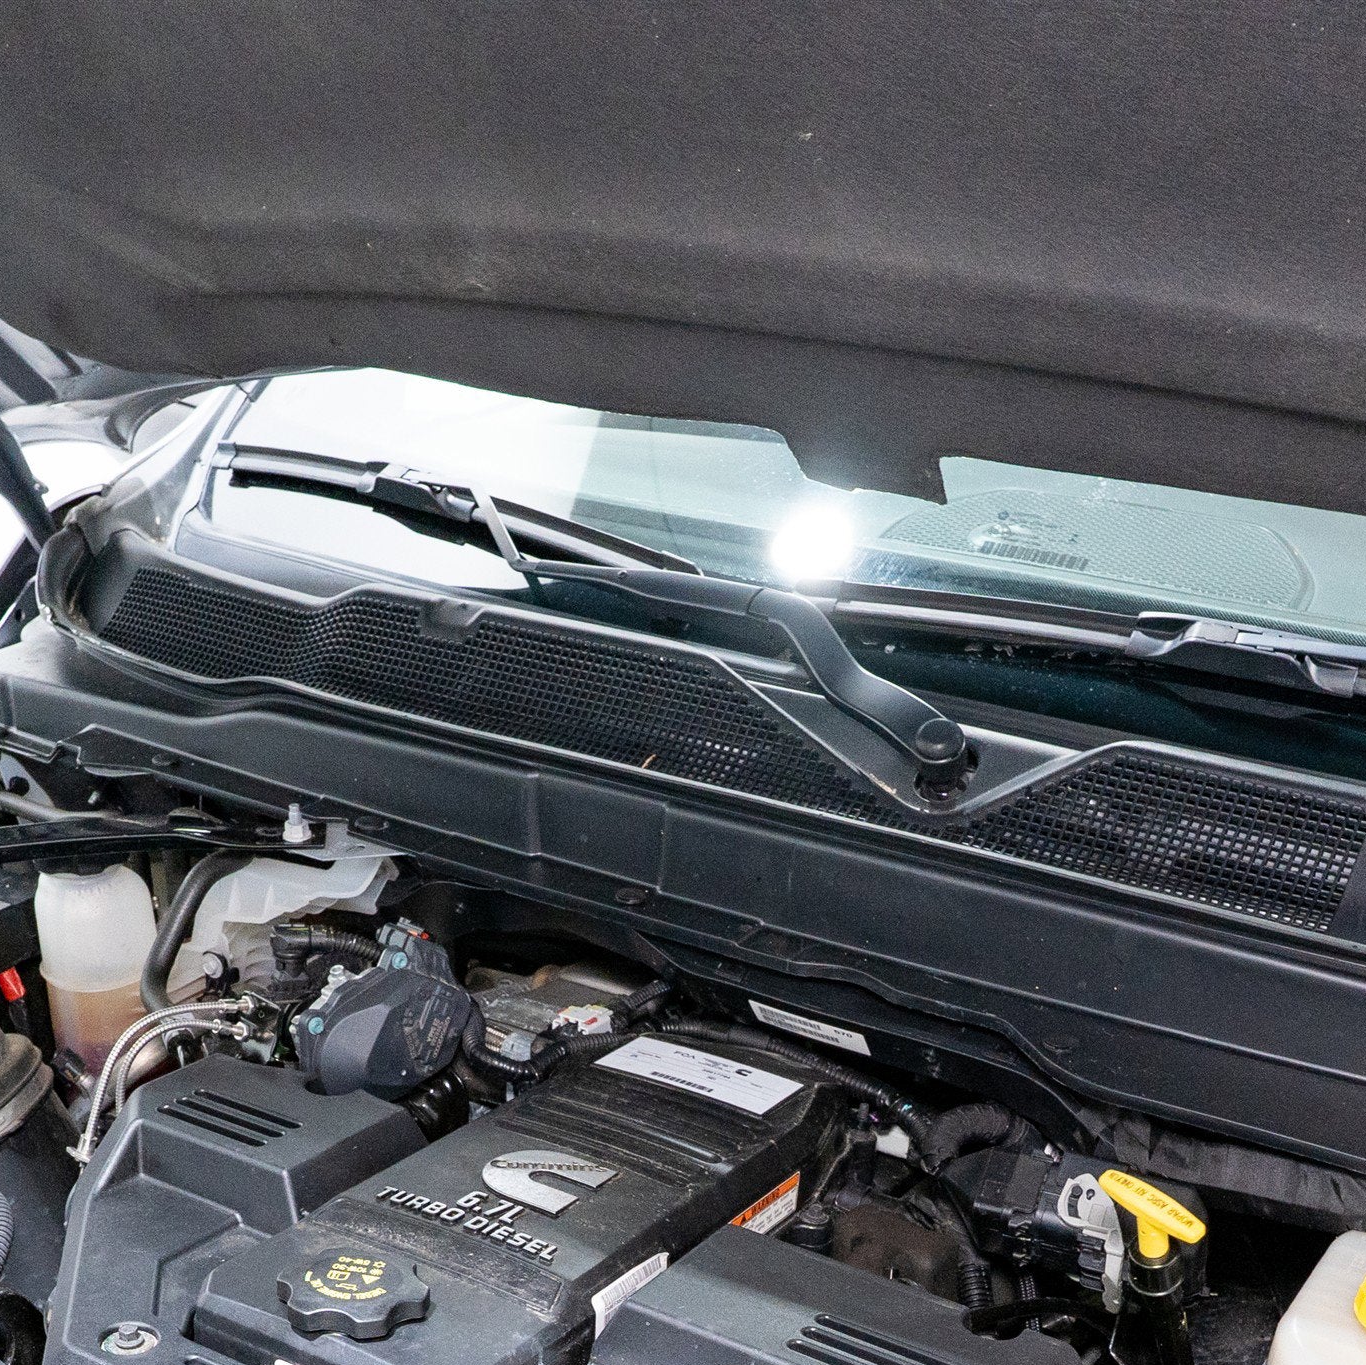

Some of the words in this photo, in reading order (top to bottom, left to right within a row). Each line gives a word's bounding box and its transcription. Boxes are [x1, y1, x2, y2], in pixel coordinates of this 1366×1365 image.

[490, 1158, 610, 1173] Cummins
[376, 1186, 465, 1222] TURBO
[463, 1215, 559, 1262] DIESEL
[457, 1190, 525, 1225] 6.7L
